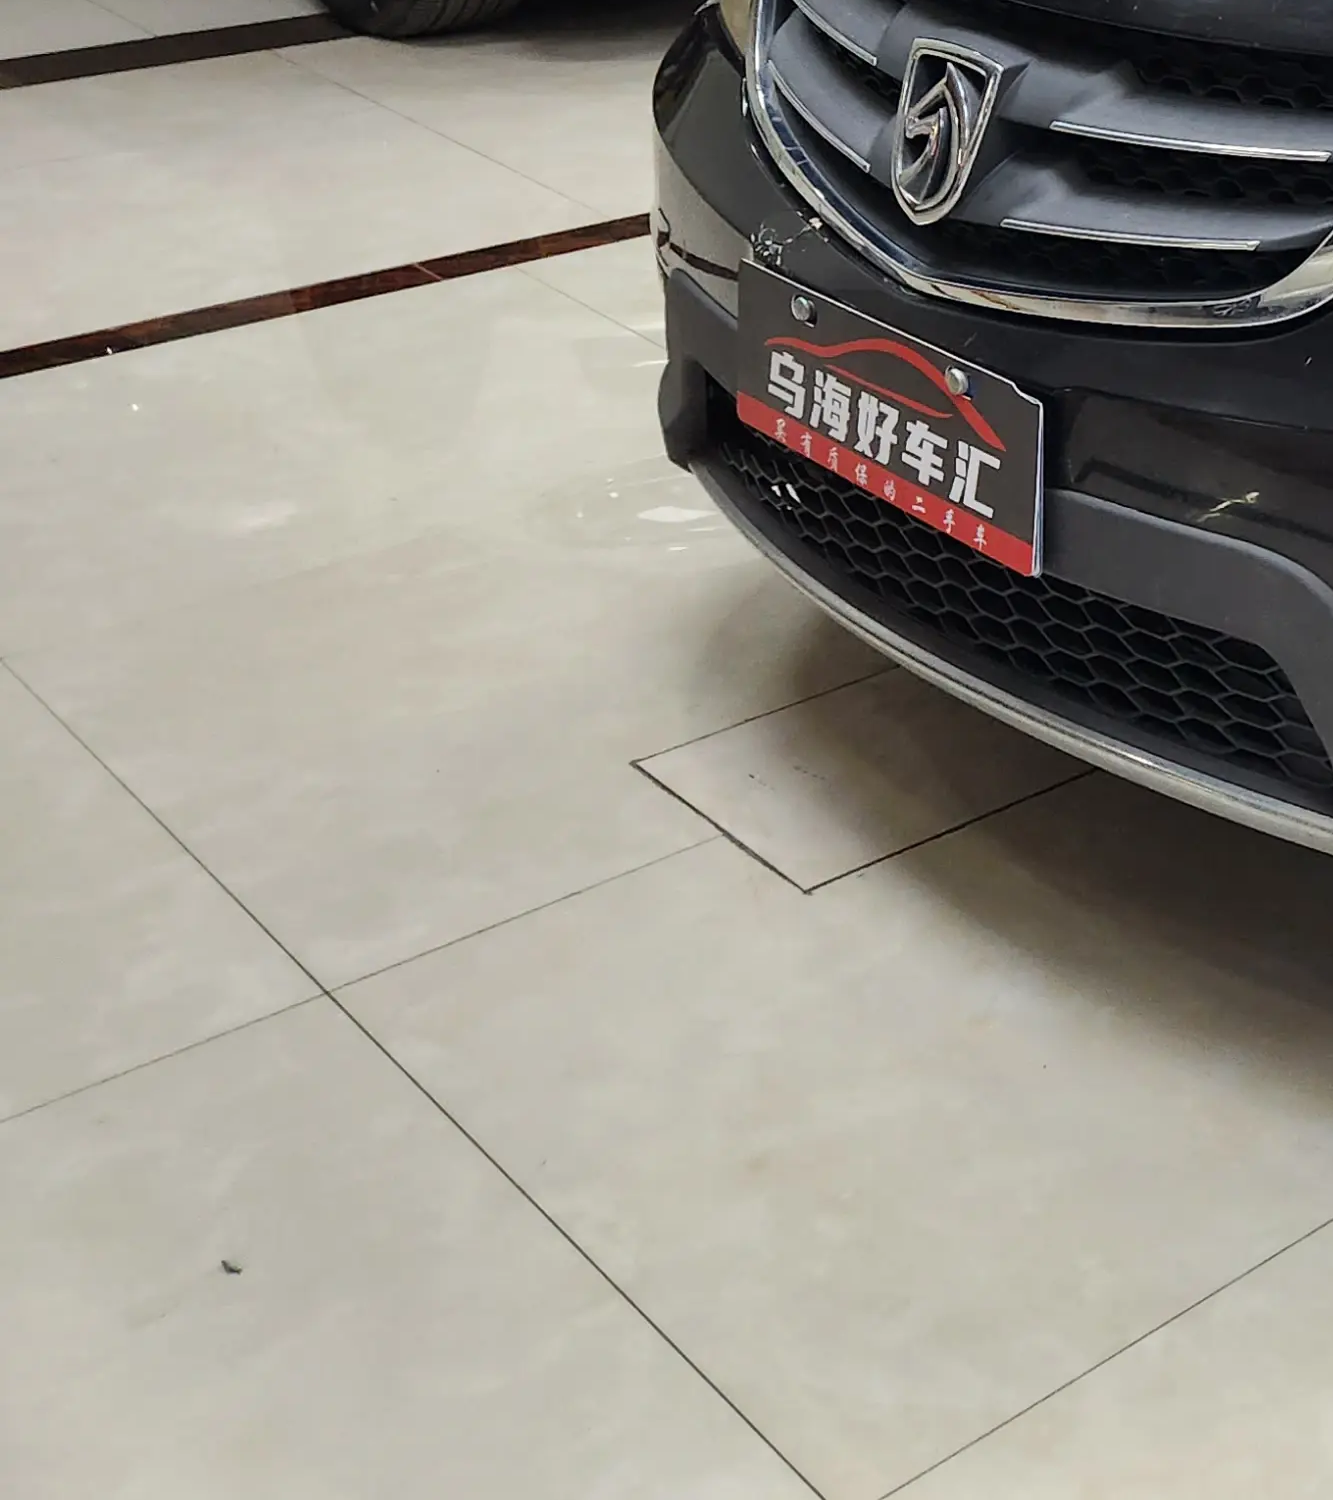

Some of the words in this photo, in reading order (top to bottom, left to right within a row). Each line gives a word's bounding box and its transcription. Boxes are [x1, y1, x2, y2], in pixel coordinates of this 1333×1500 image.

[766, 350, 1001, 520] 乌海好车汇
